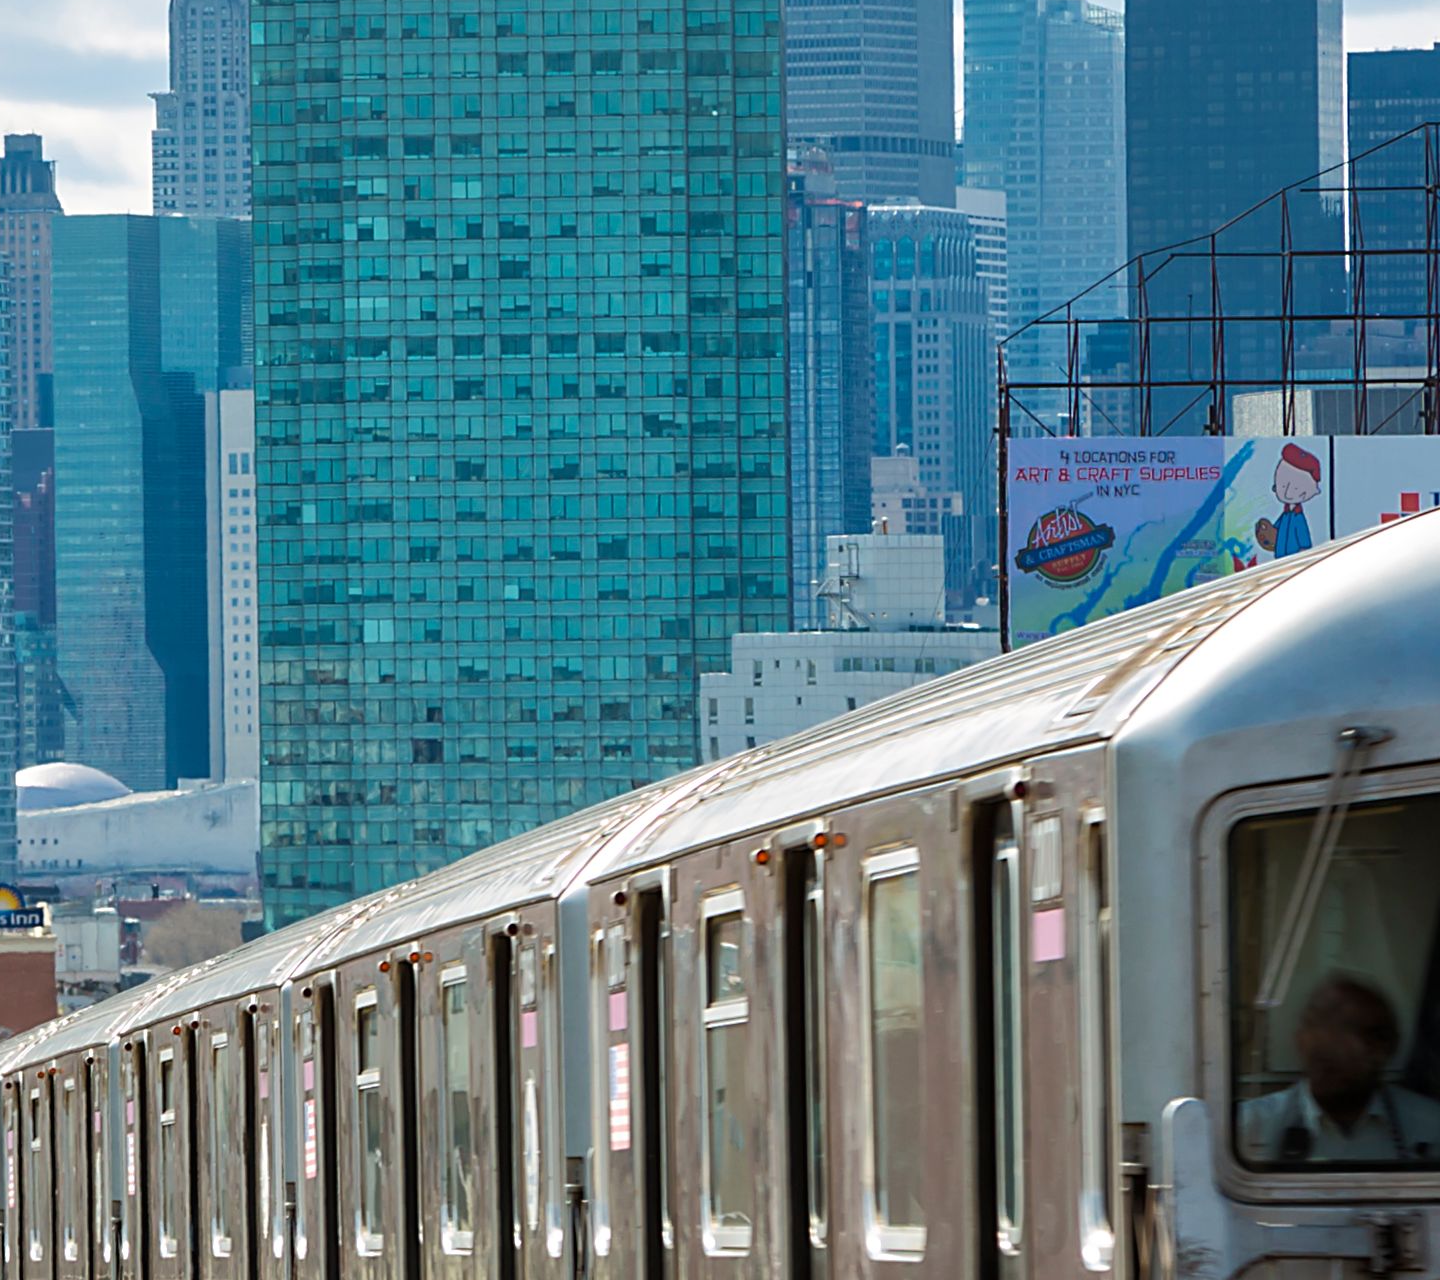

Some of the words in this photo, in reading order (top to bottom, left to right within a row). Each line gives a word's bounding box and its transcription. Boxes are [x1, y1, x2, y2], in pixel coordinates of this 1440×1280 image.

[1060, 450, 1069, 464] 4
[1074, 451, 1146, 463] LOCATIONS
[1149, 451, 1176, 464] FOR
[1015, 468, 1054, 483] ART
[1058, 468, 1071, 482] &
[1077, 467, 1132, 483] CRAFT
[1139, 466, 1221, 481] SUPPLIES
[1096, 485, 1110, 496] IN
[1113, 484, 1141, 497] NYC
[1039, 532, 1106, 561] CRAFTSMAN
